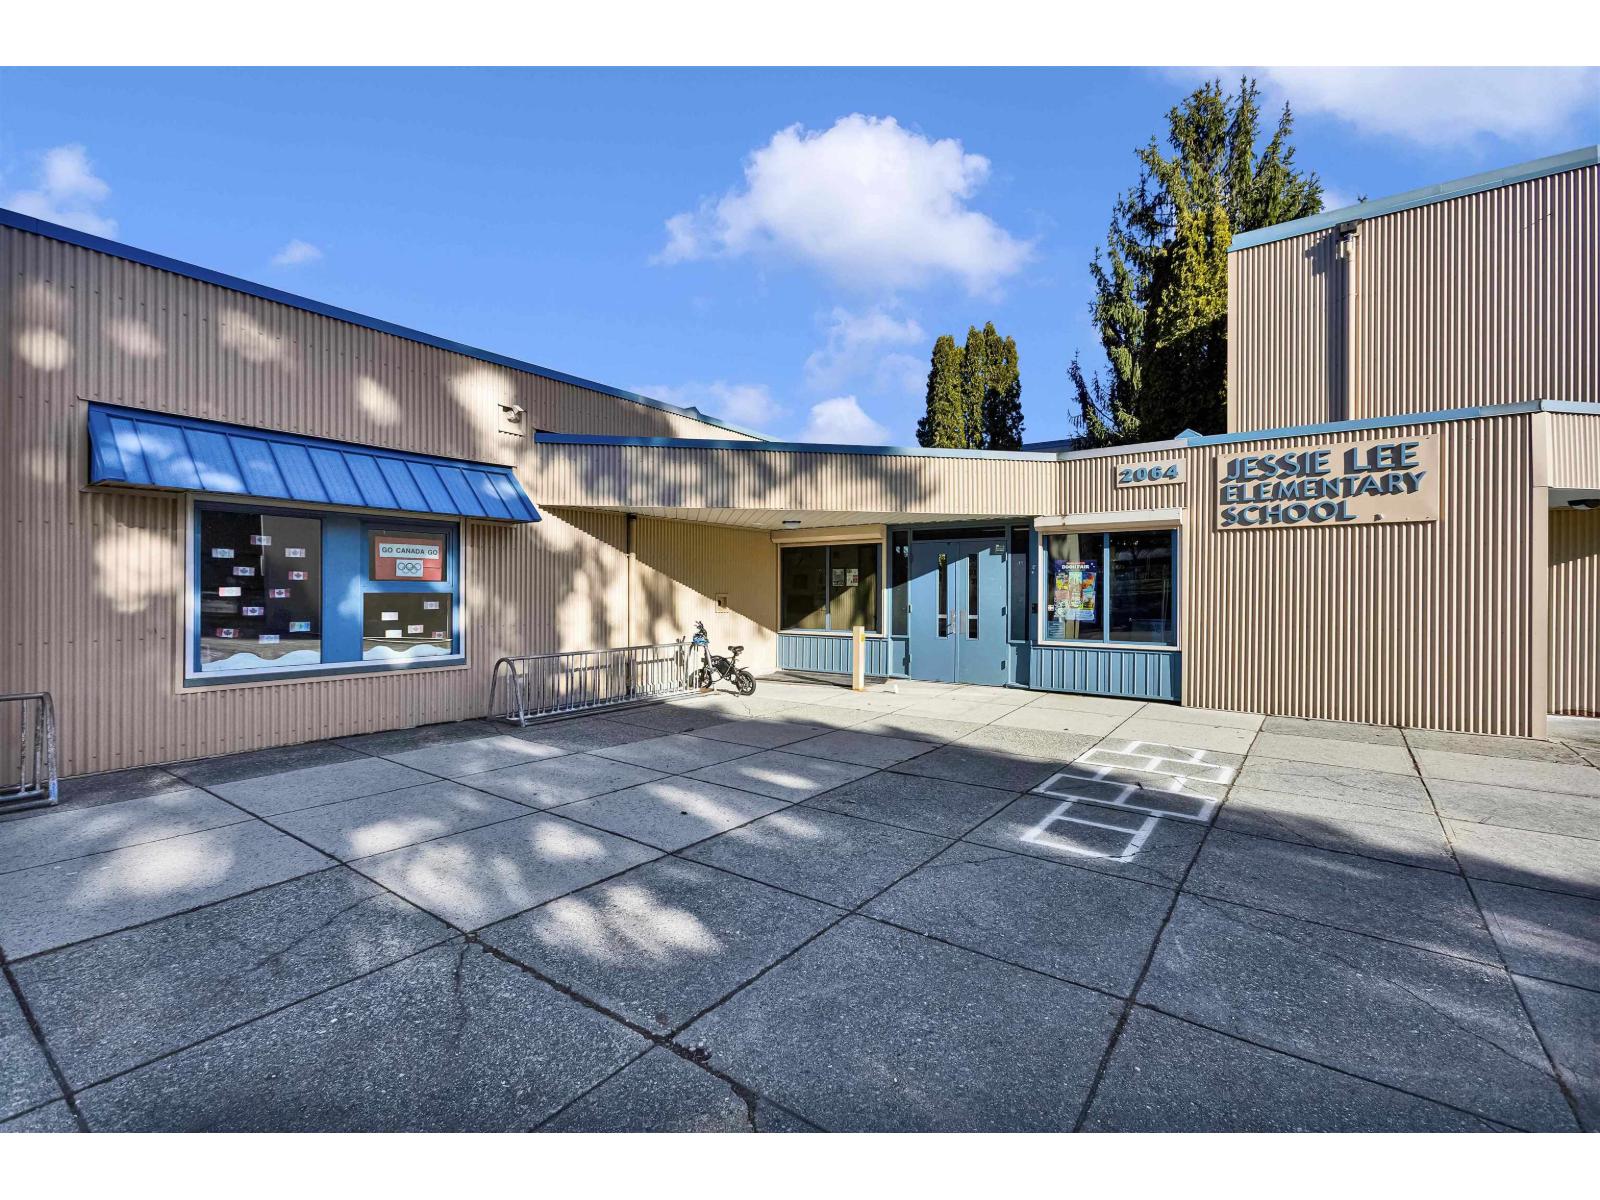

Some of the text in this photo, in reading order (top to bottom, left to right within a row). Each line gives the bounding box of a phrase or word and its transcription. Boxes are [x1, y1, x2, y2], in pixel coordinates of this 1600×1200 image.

[1228, 442, 1420, 480] JESSIE LEE
[1118, 464, 1179, 484] 2064
[1226, 471, 1427, 502] ELEMENTARY
[1225, 500, 1359, 525] SCHOOL
[395, 547, 425, 555] CANADA
